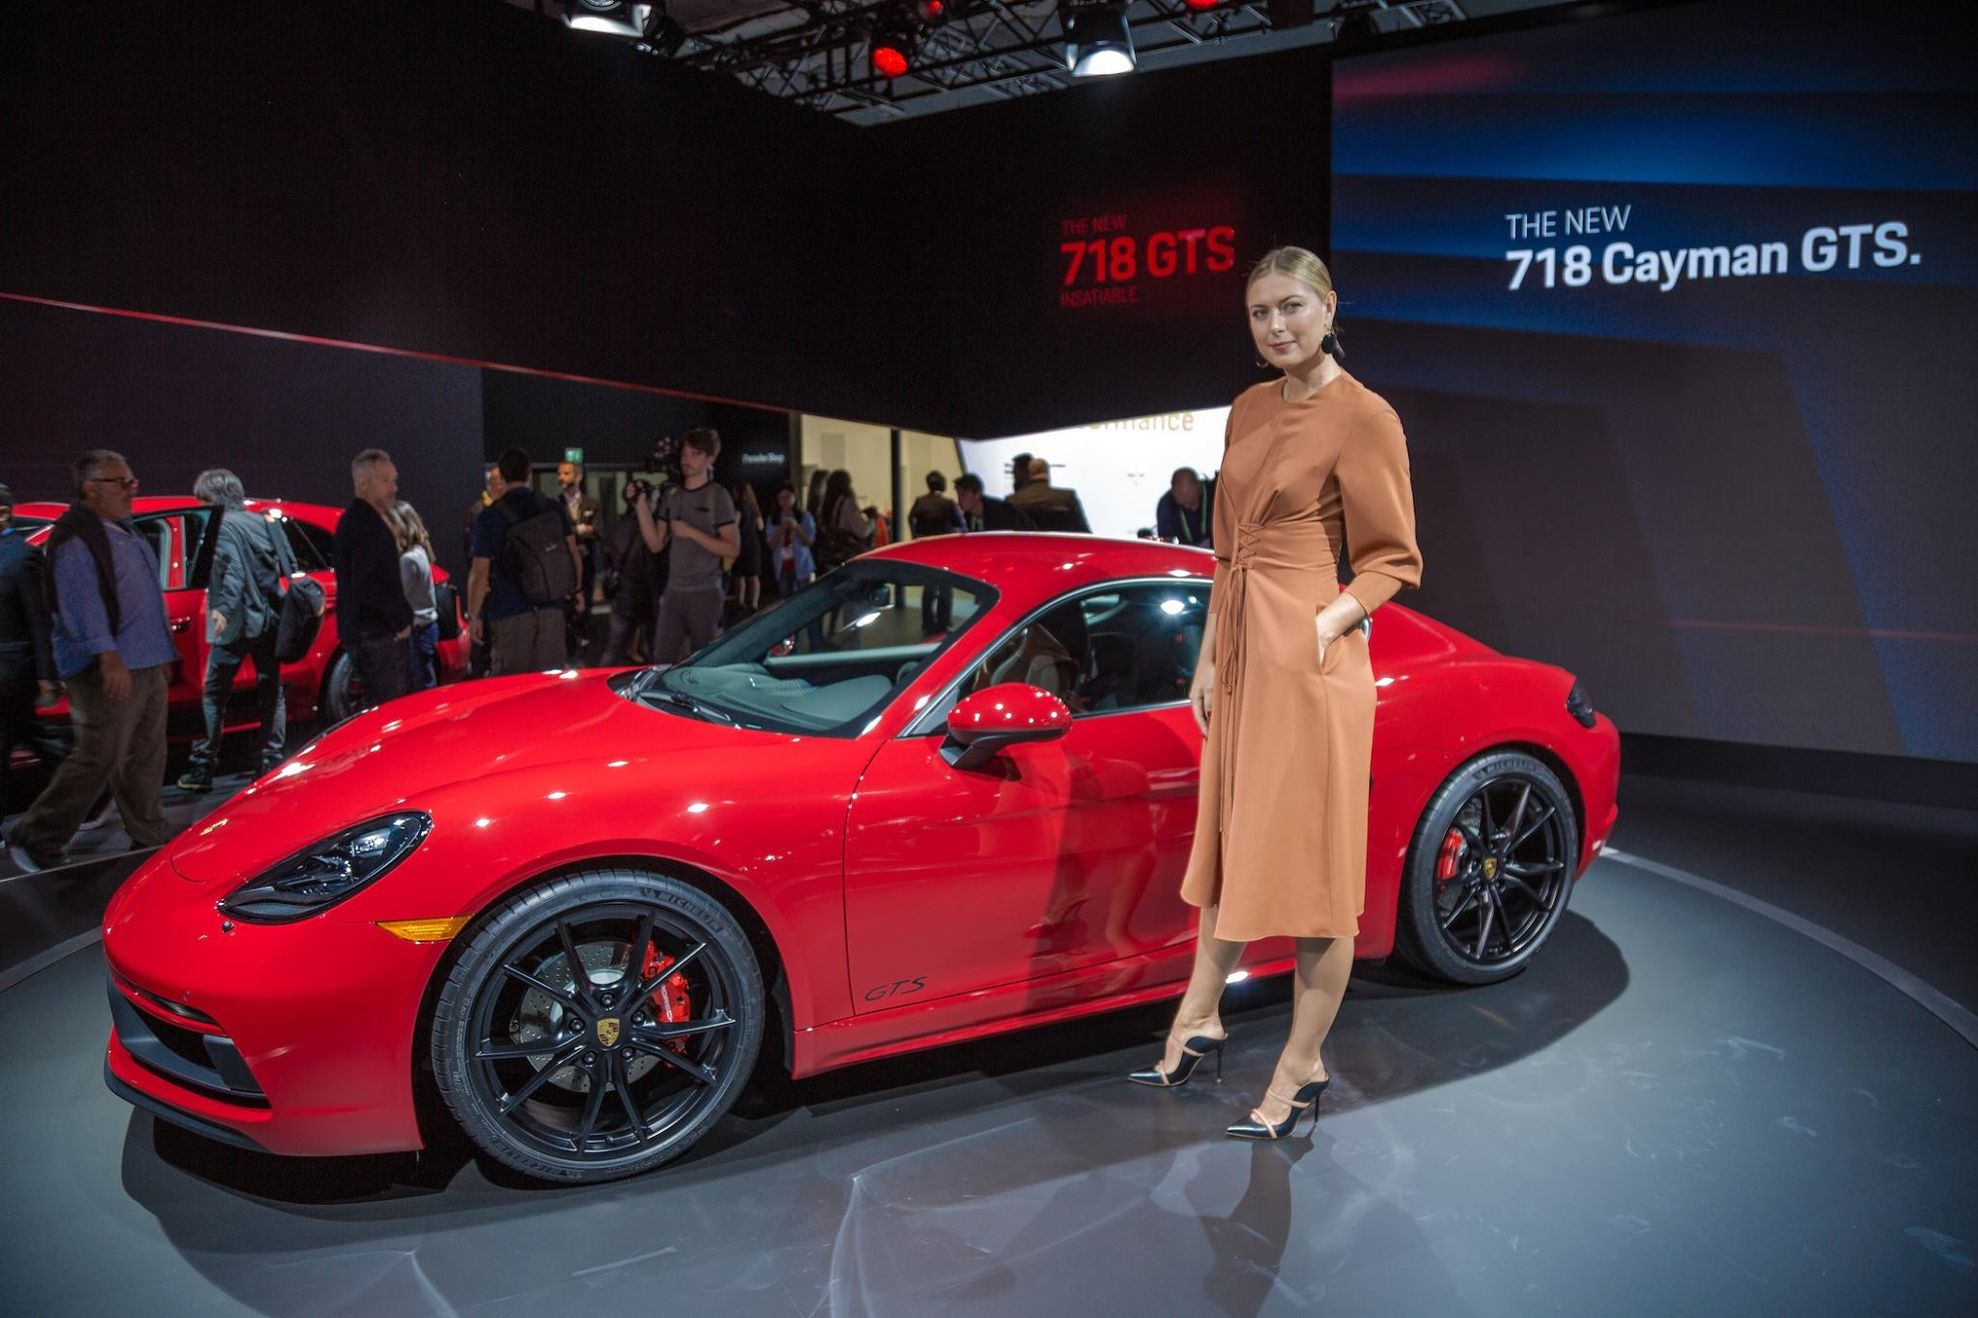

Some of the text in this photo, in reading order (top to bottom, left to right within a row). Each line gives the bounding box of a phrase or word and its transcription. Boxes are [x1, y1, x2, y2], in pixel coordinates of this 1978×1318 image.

[1060, 213, 1127, 236] THE NEW
[1505, 204, 1632, 240] THE NEW
[1060, 224, 1236, 286] 718 GTS
[1505, 220, 1921, 292] 718 Cayman GTS.
[864, 975, 928, 1002] GTS
